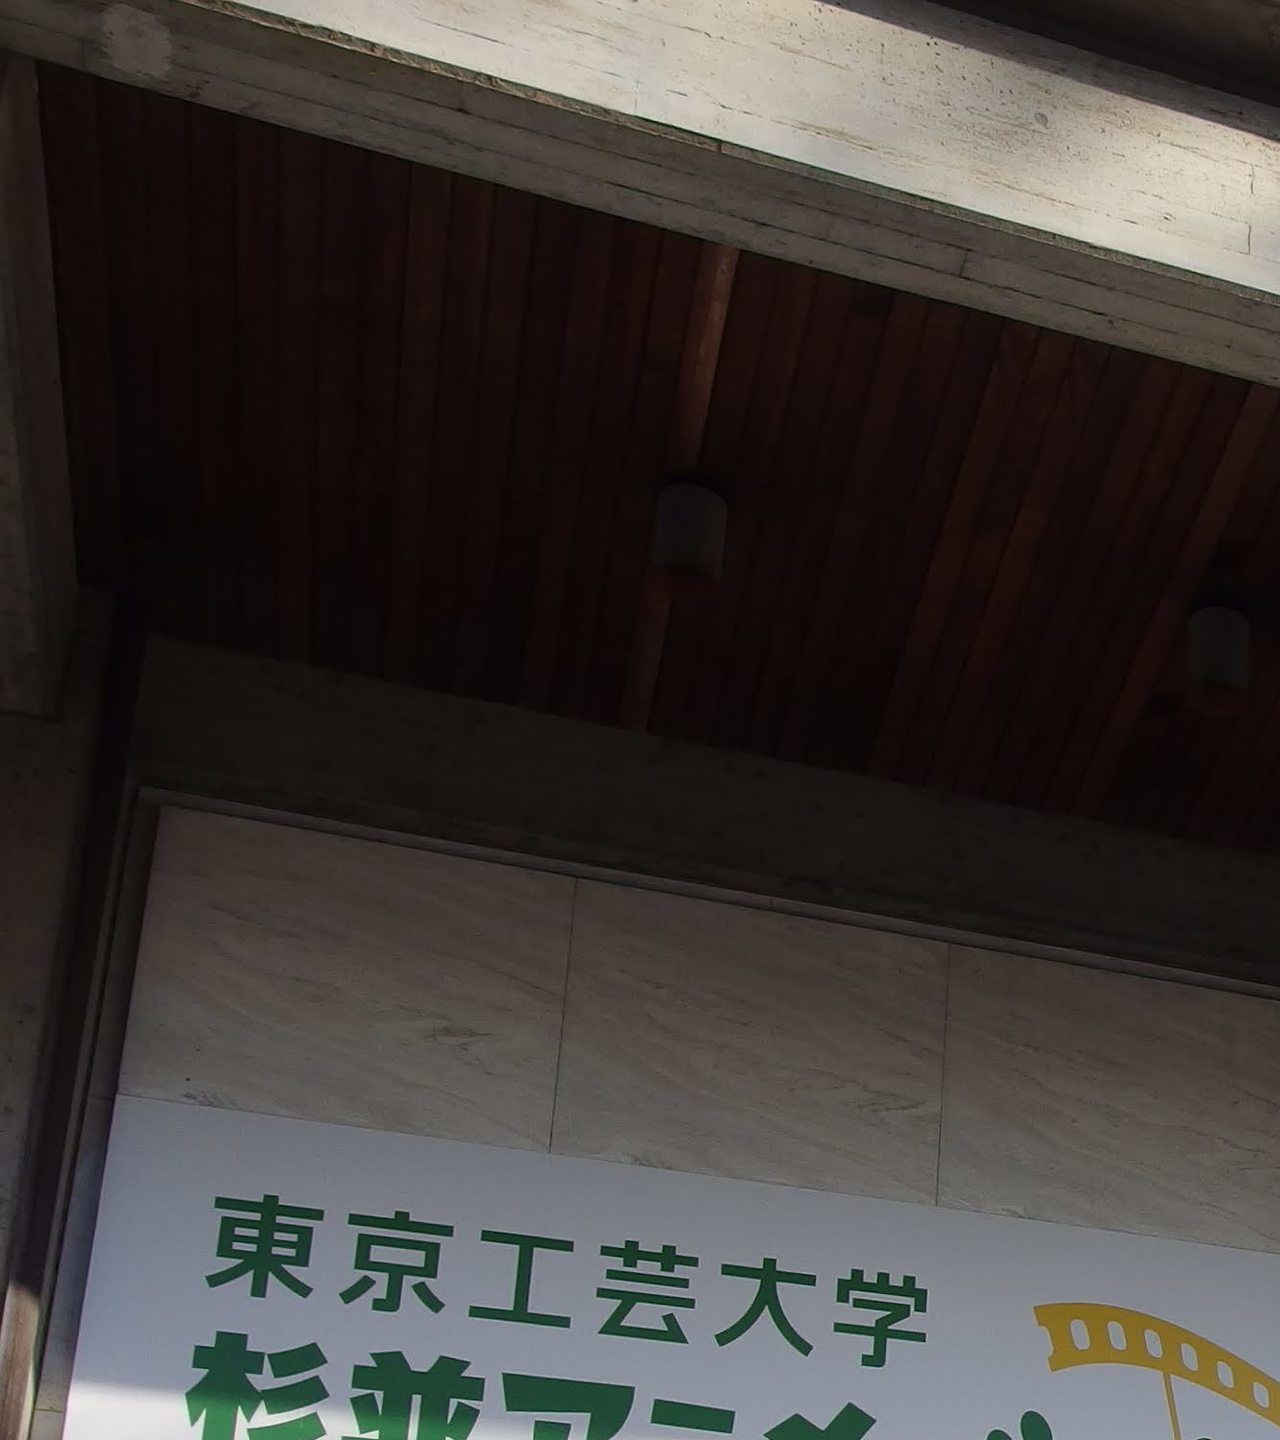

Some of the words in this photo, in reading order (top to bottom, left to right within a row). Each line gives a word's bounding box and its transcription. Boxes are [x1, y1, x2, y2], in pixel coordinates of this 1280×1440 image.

[204, 1194, 929, 1369] 東京工芸大学
